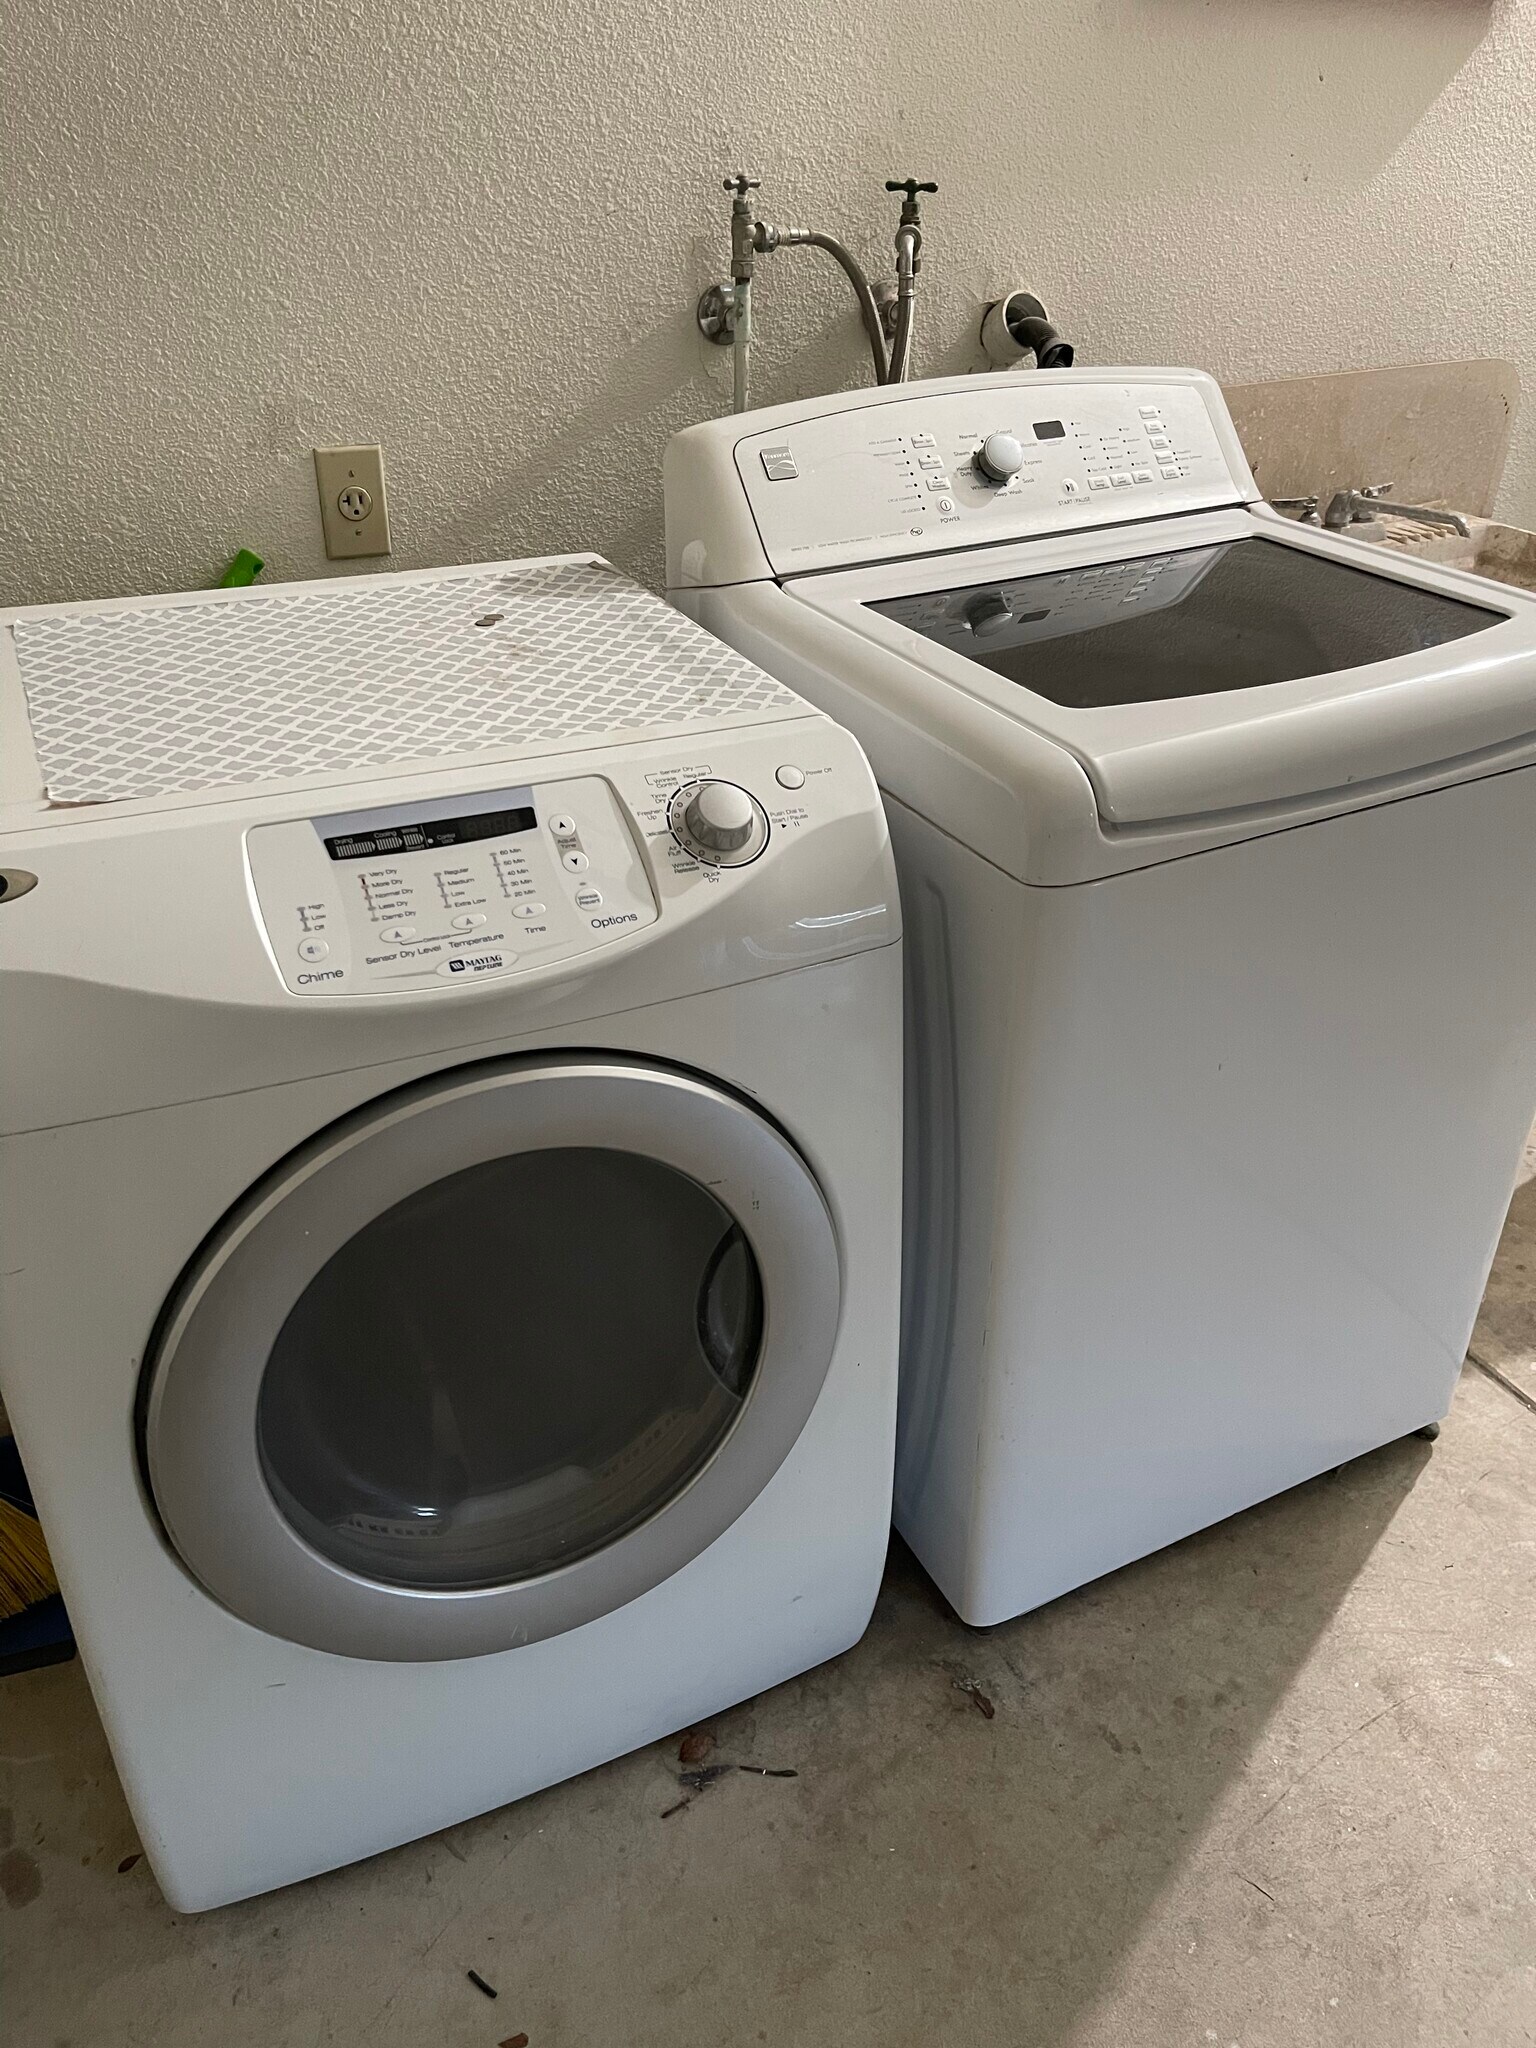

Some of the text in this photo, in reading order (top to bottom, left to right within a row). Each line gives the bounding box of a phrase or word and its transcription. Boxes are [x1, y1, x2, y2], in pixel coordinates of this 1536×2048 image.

[940, 516, 960, 524] POWER
[591, 913, 638, 929] Options
[525, 925, 547, 934] Time
[448, 934, 504, 949] Temperature
[366, 944, 442, 965] Sensor Dry Level
[465, 955, 502, 967] MAYTAG
[297, 969, 344, 985] Chime
